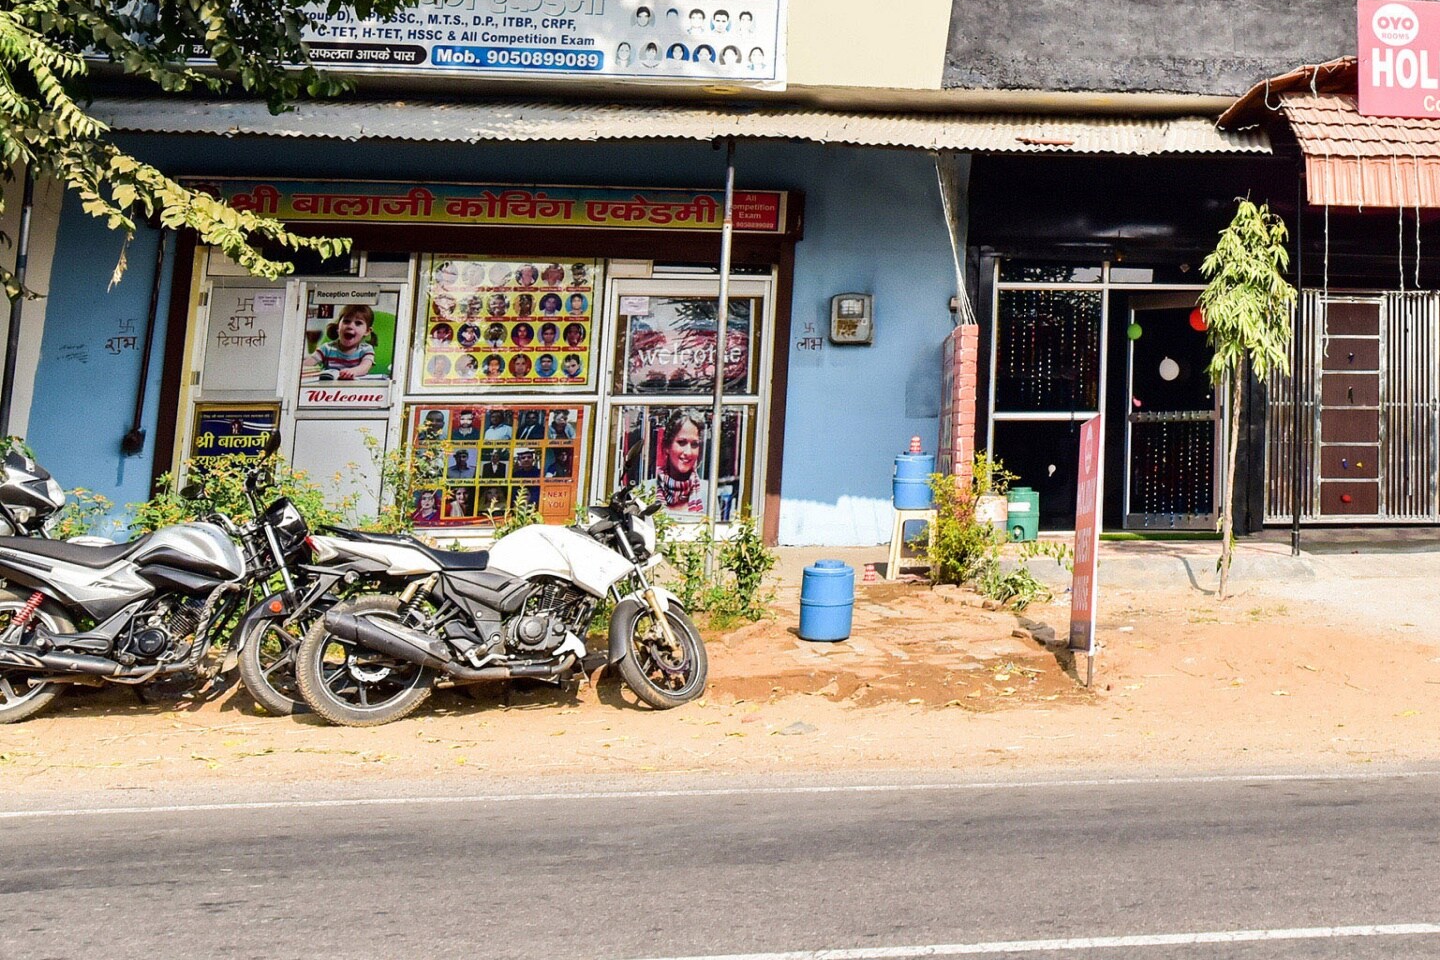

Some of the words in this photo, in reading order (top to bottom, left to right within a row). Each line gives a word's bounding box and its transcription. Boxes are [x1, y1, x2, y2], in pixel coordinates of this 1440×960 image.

[427, 14, 468, 28] M.T.S.,
[473, 16, 499, 29] D.P.,
[503, 17, 537, 30] ITBP.,
[541, 18, 577, 31] CRPF,
[1377, 16, 1414, 31] OYO
[318, 26, 358, 39] C-TET,
[362, 27, 403, 41] H-TET,
[407, 29, 443, 41] HSSC
[447, 31, 457, 41] &
[461, 31, 478, 42] All
[481, 32, 557, 46] Competition
[561, 34, 595, 46] Exam
[1381, 32, 1410, 40] ROOMS
[309, 48, 353, 60] सफलता
[356, 47, 390, 61] आपके
[393, 51, 416, 62] पास
[437, 48, 481, 64] Mob.
[487, 50, 599, 67] 9050899089
[230, 185, 282, 215] श्री
[291, 187, 436, 218] बालाजी
[445, 190, 576, 220] कोचिंग
[585, 194, 719, 224] एकेडमी
[731, 203, 775, 211] ompetition
[739, 211, 761, 219] Exam
[317, 290, 350, 300] Reception
[351, 290, 377, 299] Counter
[307, 389, 384, 403] Welcome
[195, 431, 215, 449] श्री
